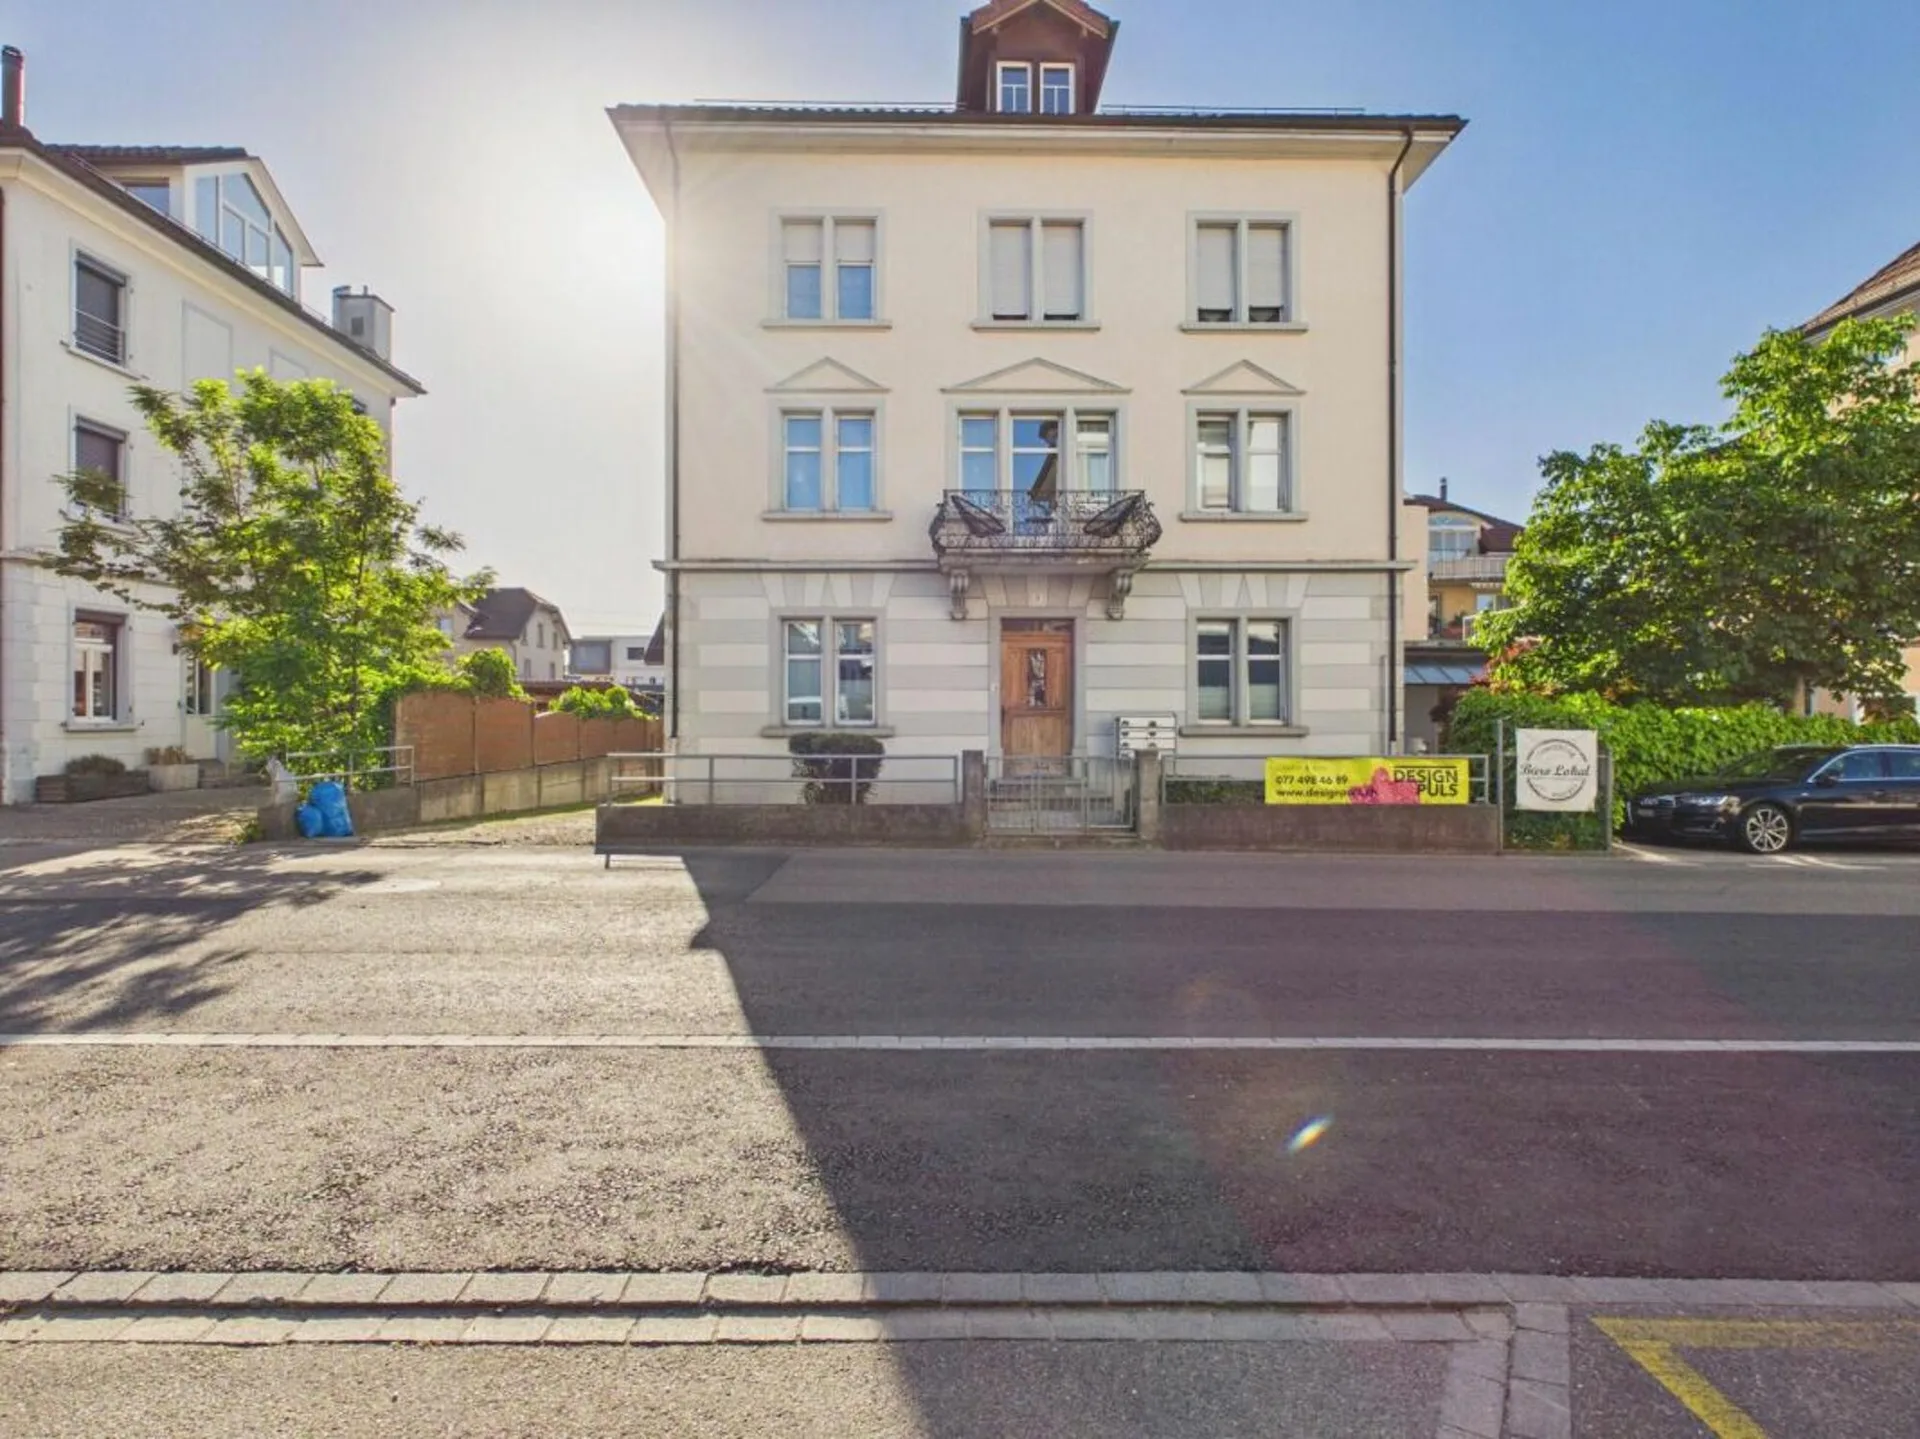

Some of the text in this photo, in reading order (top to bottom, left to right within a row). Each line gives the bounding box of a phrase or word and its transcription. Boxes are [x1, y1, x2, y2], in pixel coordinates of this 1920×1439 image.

[1275, 775, 1295, 785] 077
[1395, 769, 1458, 784] DESIGN
[1417, 784, 1458, 797] PULS
